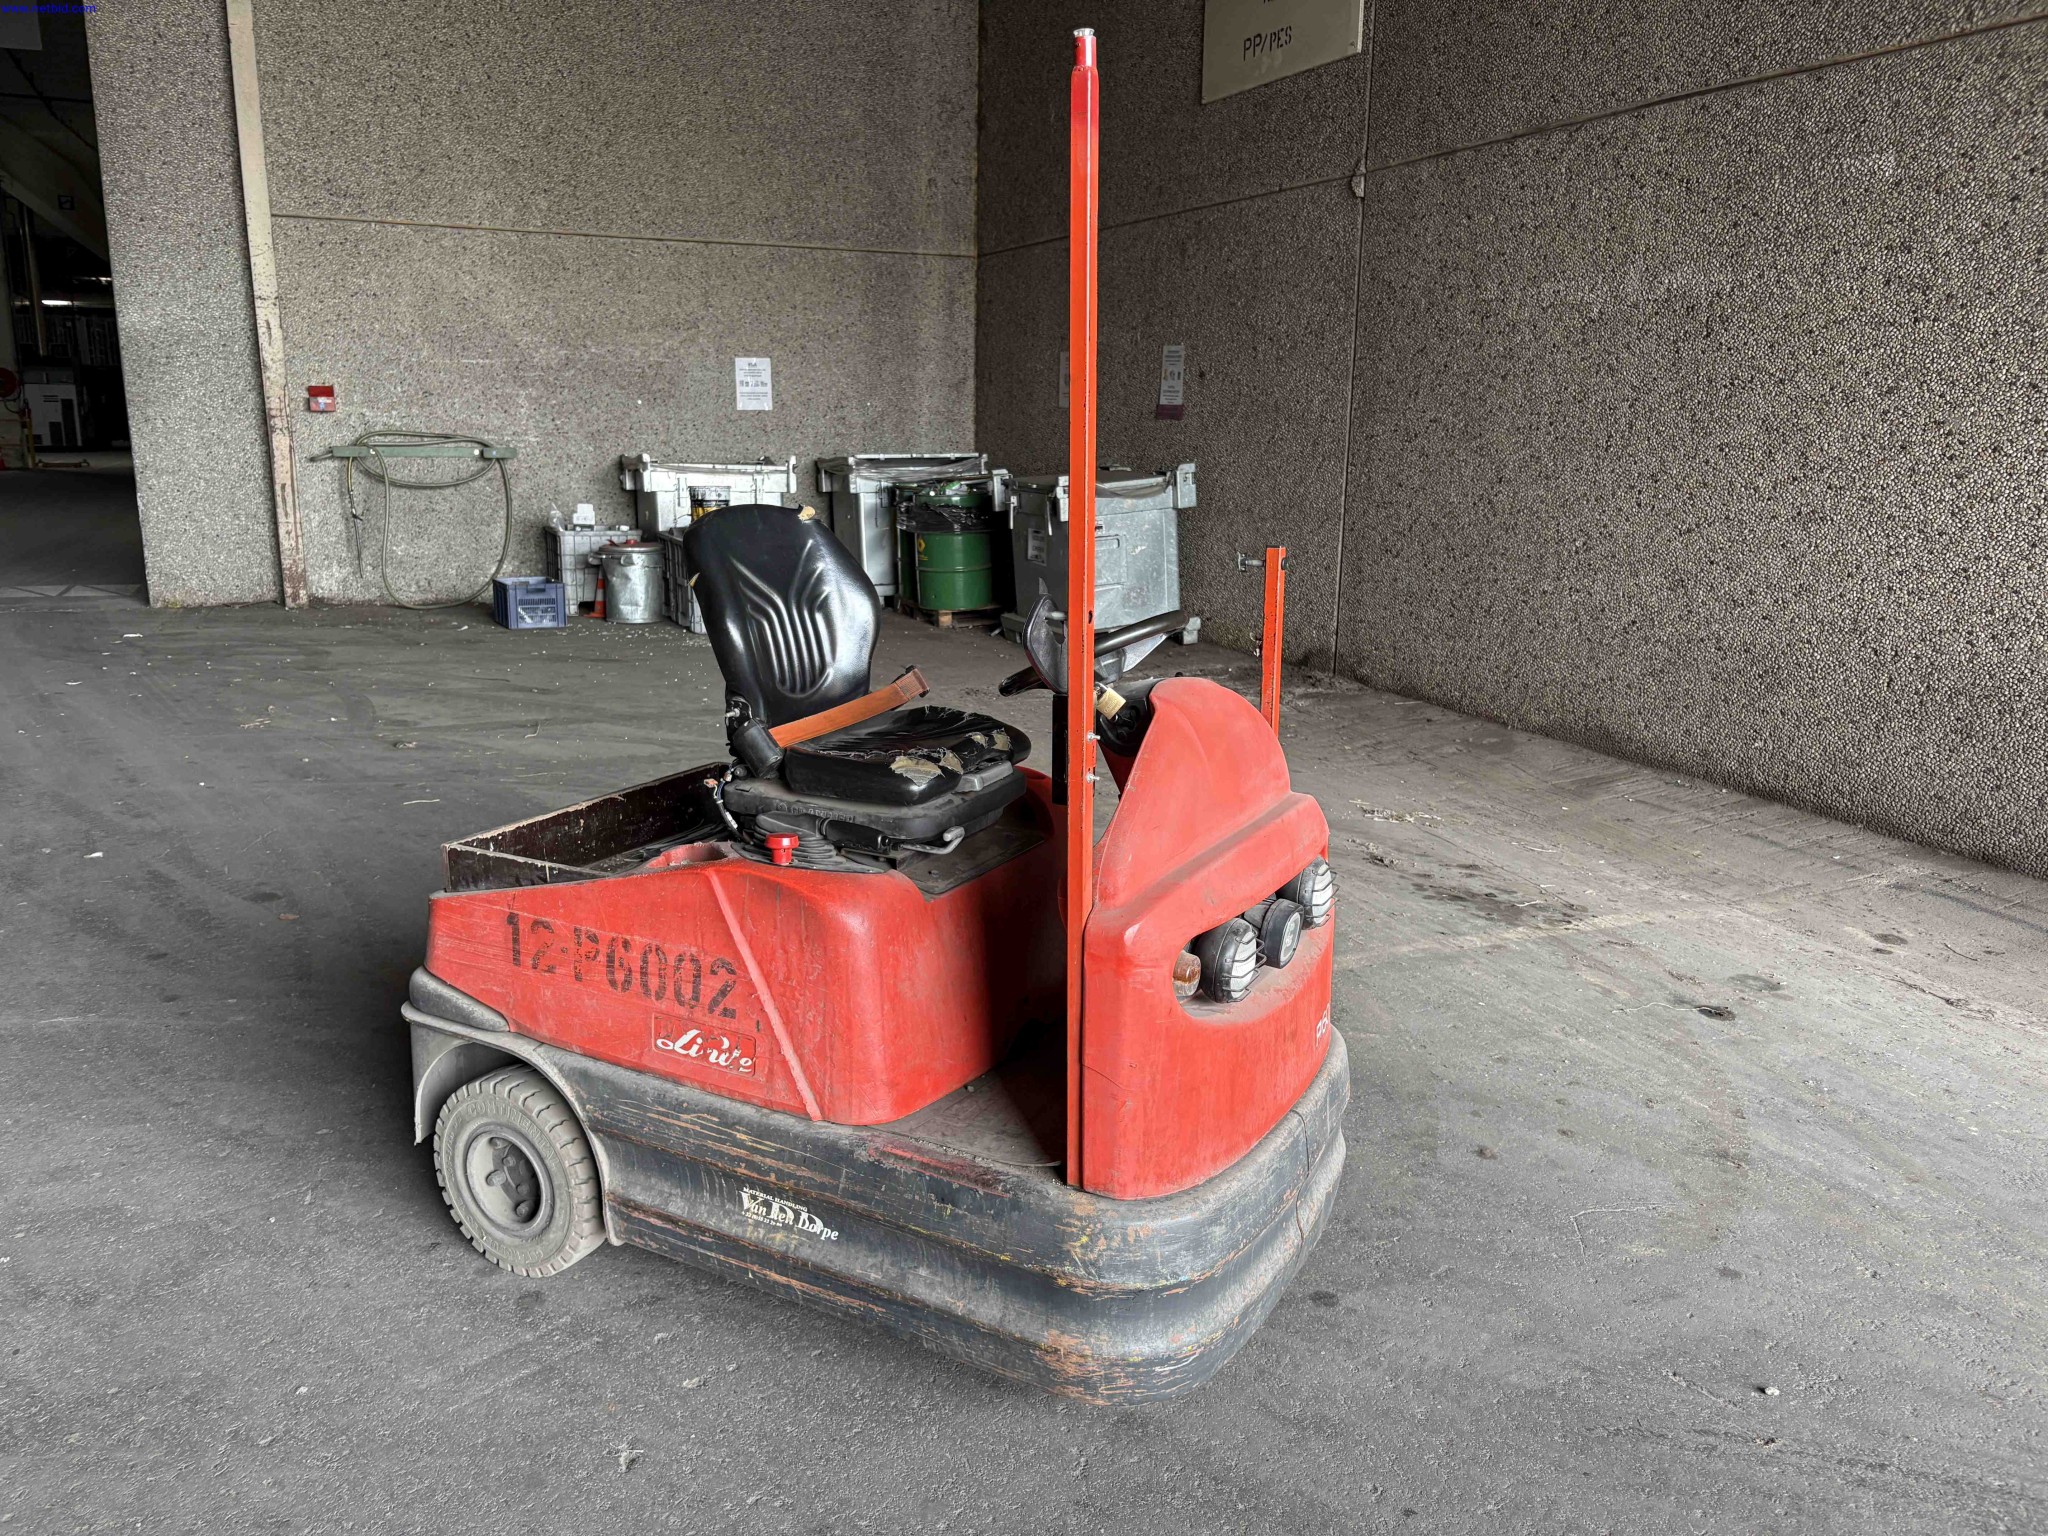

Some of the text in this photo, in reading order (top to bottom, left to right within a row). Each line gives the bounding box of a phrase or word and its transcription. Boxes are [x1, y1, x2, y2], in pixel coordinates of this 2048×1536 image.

[1243, 25, 1293, 62] PP/PES
[739, 1190, 766, 1216] Van
[795, 1209, 839, 1241] Dorpe
[743, 1186, 808, 1212] MATERIAL HANDLING
